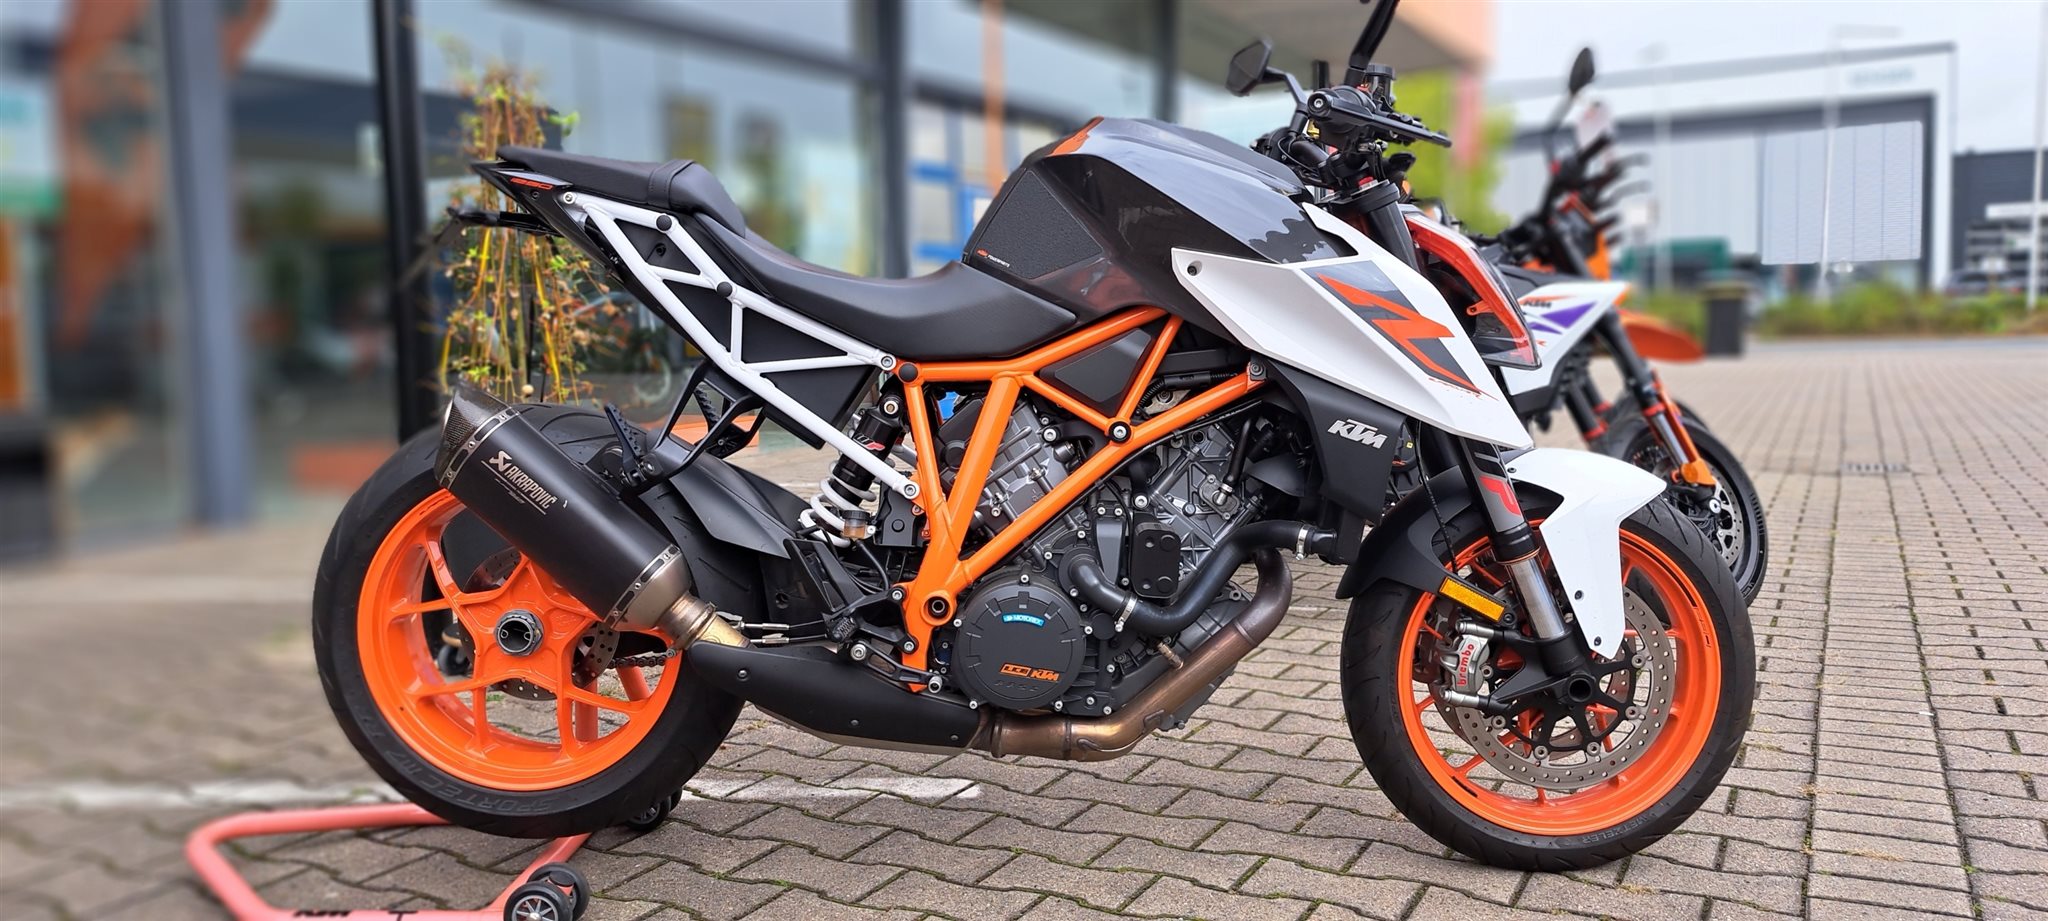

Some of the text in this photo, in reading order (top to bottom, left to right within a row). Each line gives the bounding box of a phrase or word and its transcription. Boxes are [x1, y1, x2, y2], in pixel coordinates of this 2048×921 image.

[1327, 418, 1388, 449] KTM
[1030, 669, 1060, 682] KTM
[1456, 643, 1475, 687] brembo
